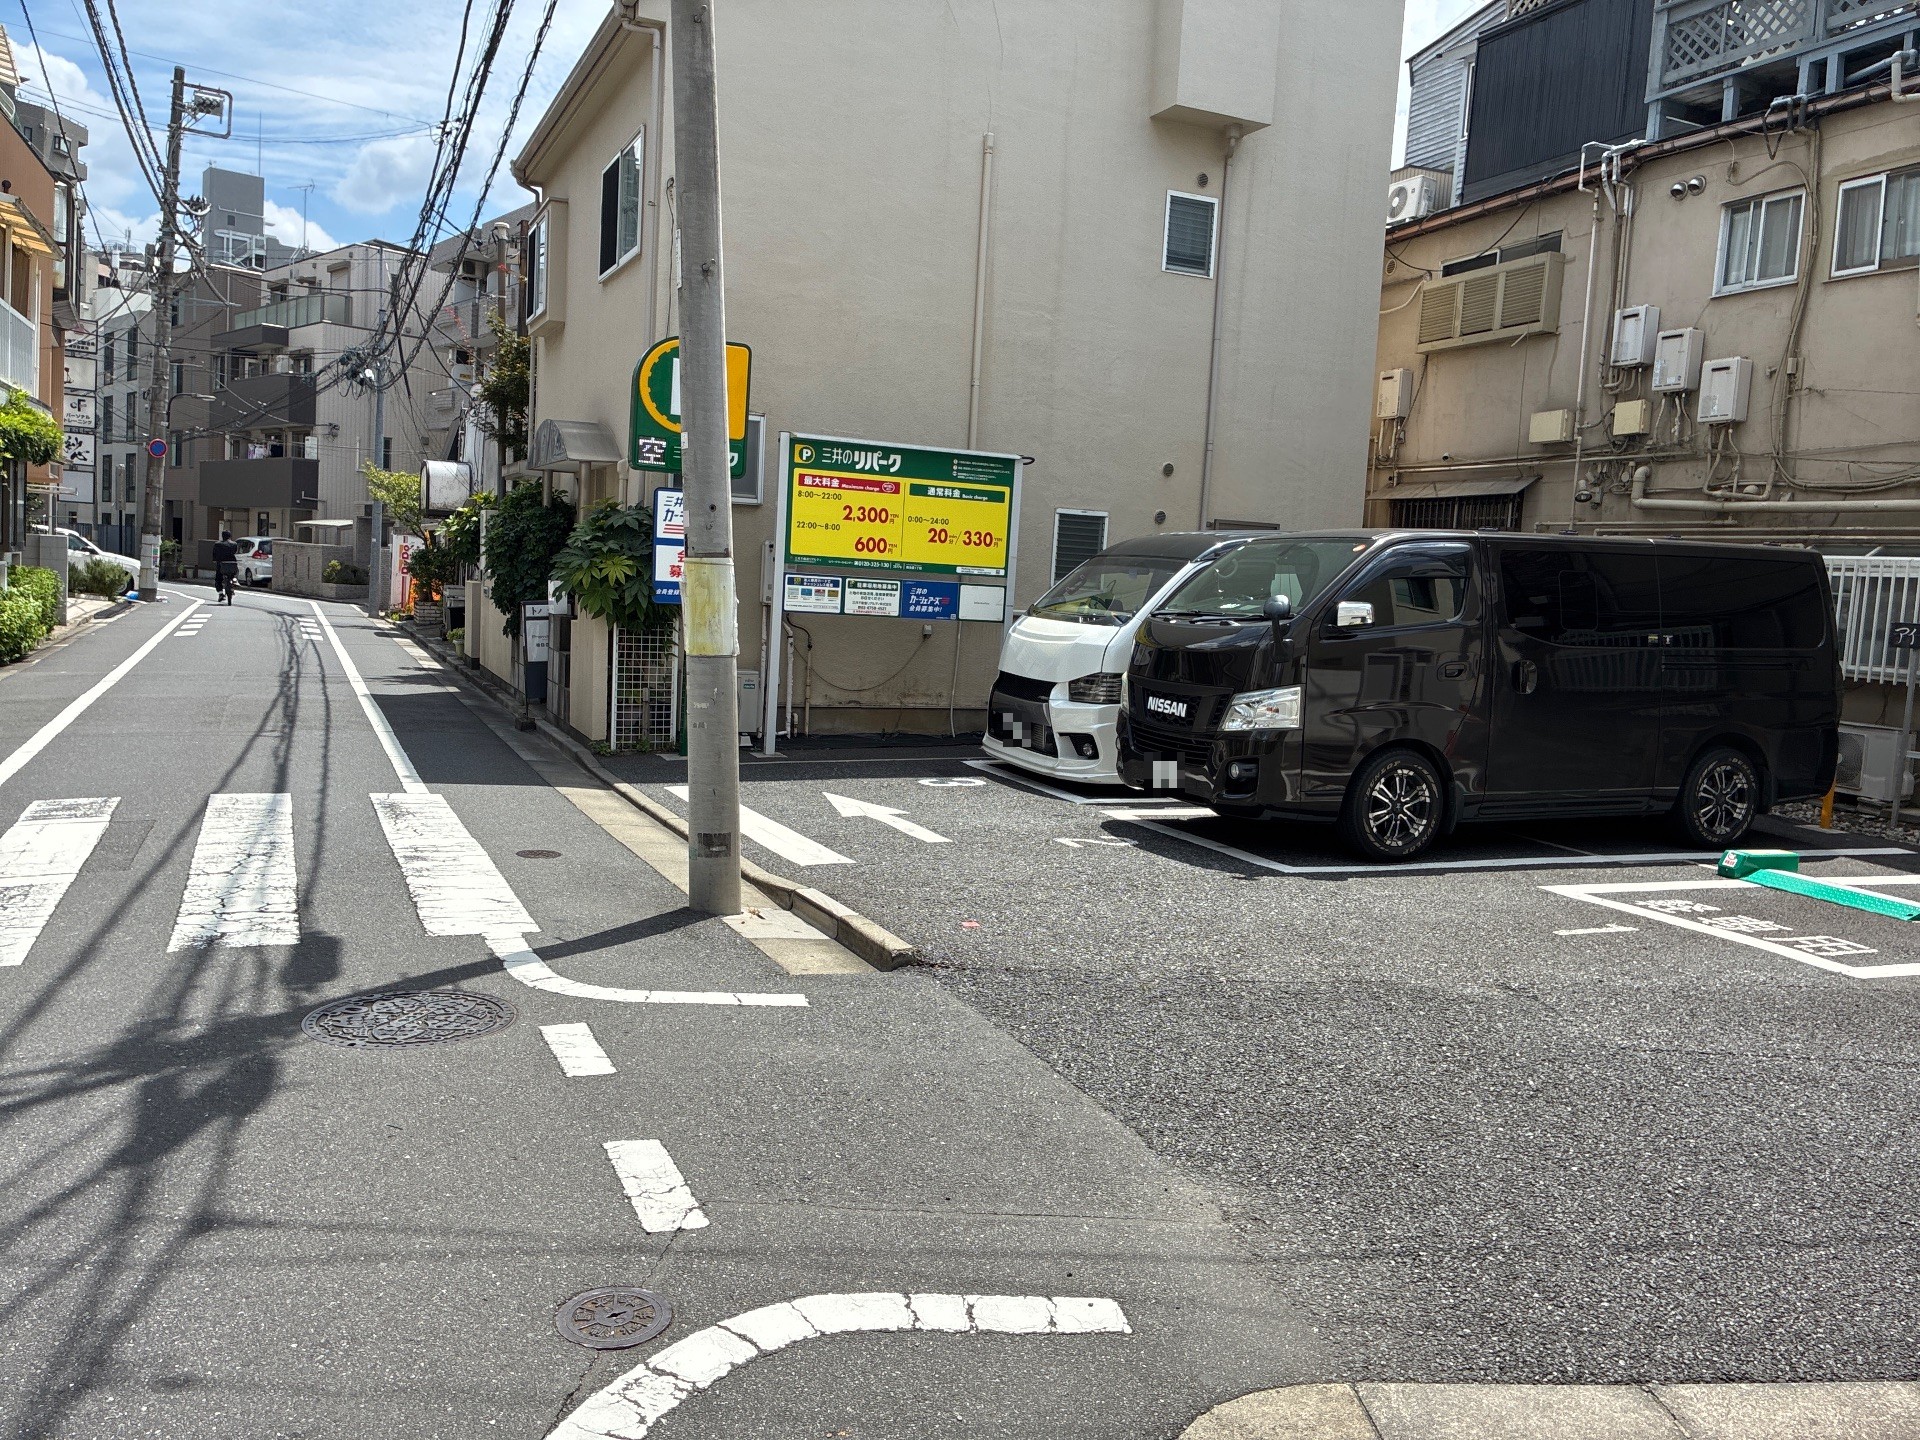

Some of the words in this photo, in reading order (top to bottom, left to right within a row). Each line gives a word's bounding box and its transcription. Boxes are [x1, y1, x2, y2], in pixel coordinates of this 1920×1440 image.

[63, 417, 93, 425] トレーニング
[638, 436, 667, 466] 空
[802, 448, 813, 461] P
[821, 447, 902, 474] 三井のリパーク
[803, 475, 841, 488] 最大料金
[927, 486, 961, 499] 通常料金
[842, 504, 891, 524] 2,300
[854, 536, 888, 554] 600
[962, 530, 994, 548] 330
[910, 587, 928, 595] 三井の
[1147, 696, 1187, 718] NISSAN
